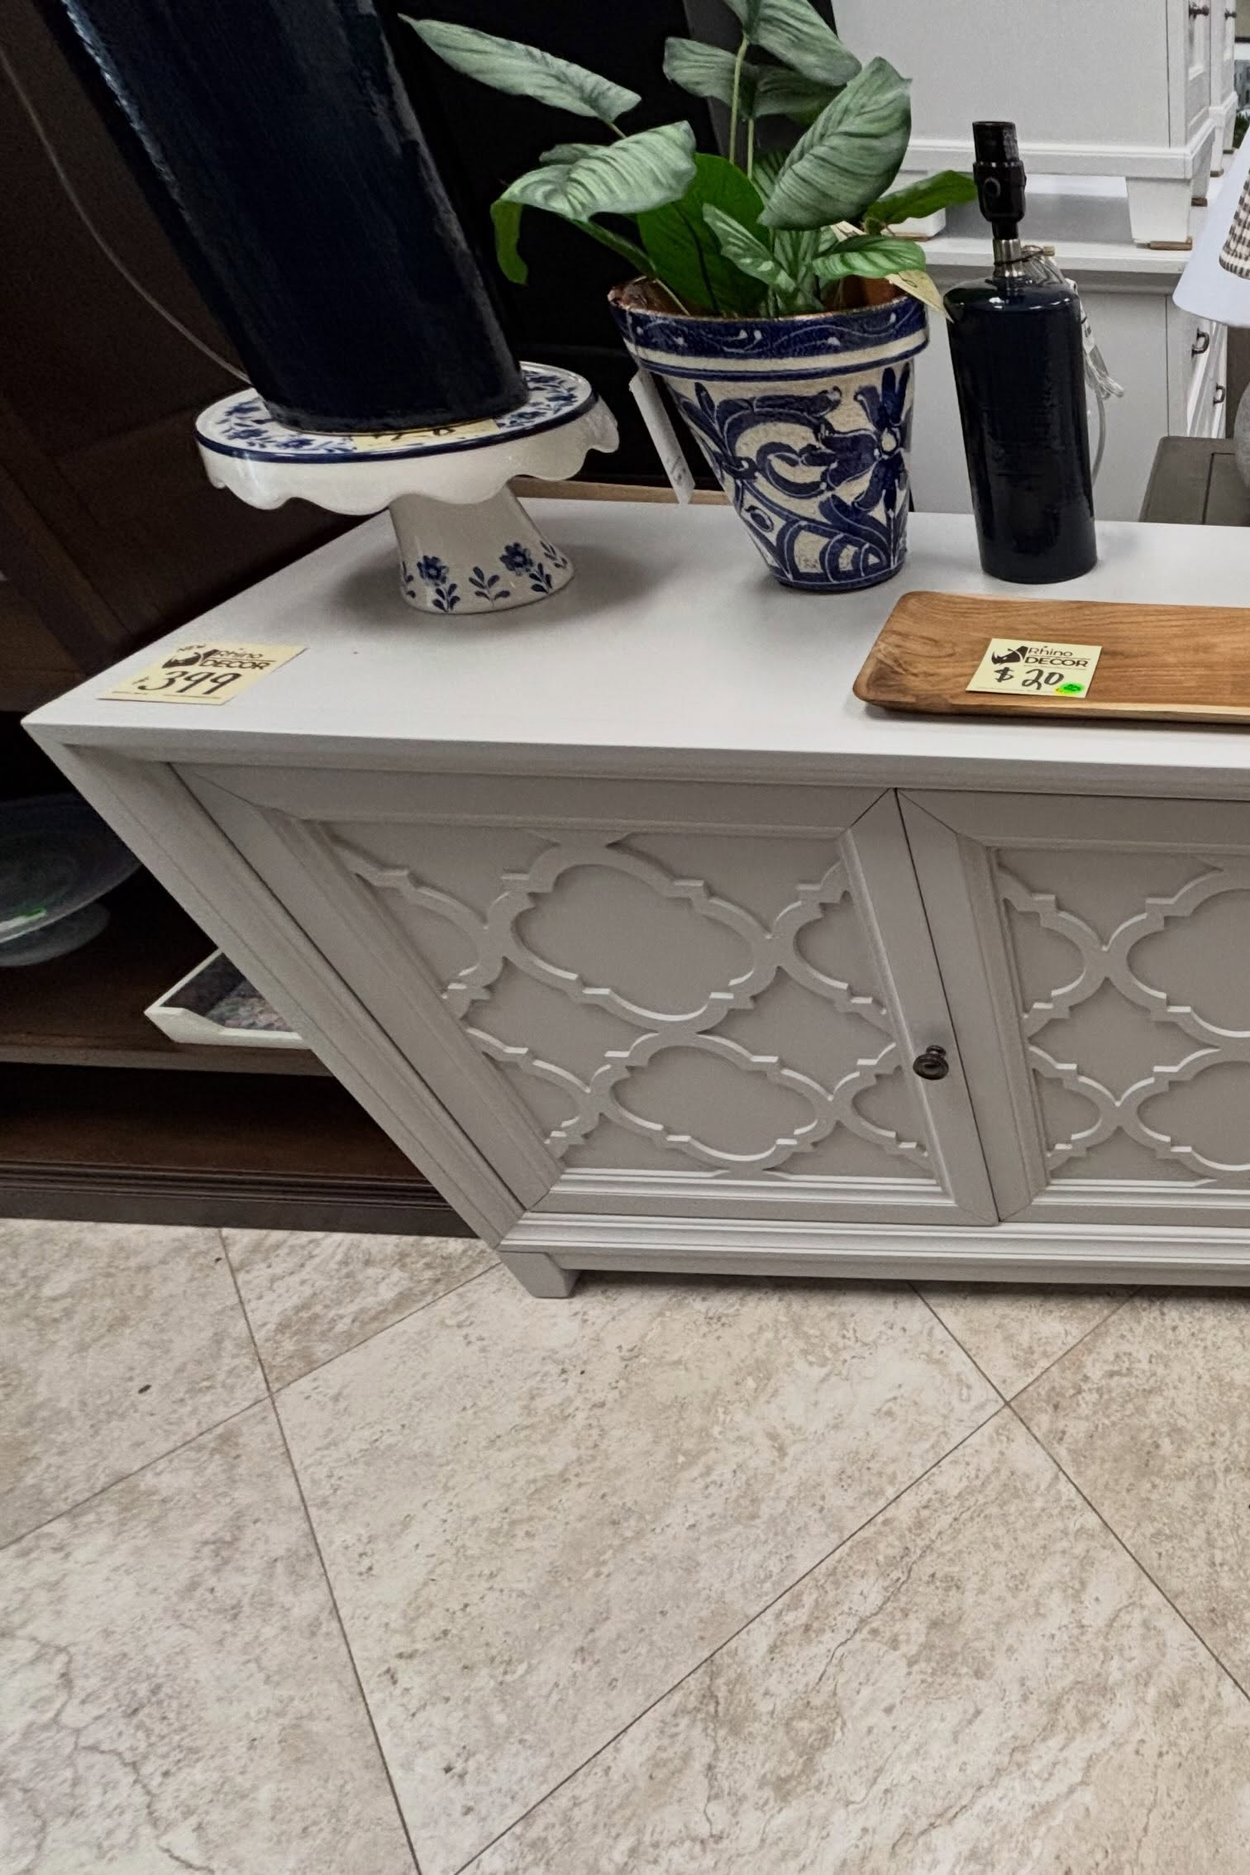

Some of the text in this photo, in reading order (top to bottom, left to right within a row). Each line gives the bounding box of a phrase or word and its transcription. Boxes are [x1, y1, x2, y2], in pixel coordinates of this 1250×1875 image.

[1028, 646, 1073, 657] Rhino
[199, 660, 271, 670] DECOR
[1024, 656, 1089, 667] DECOR
